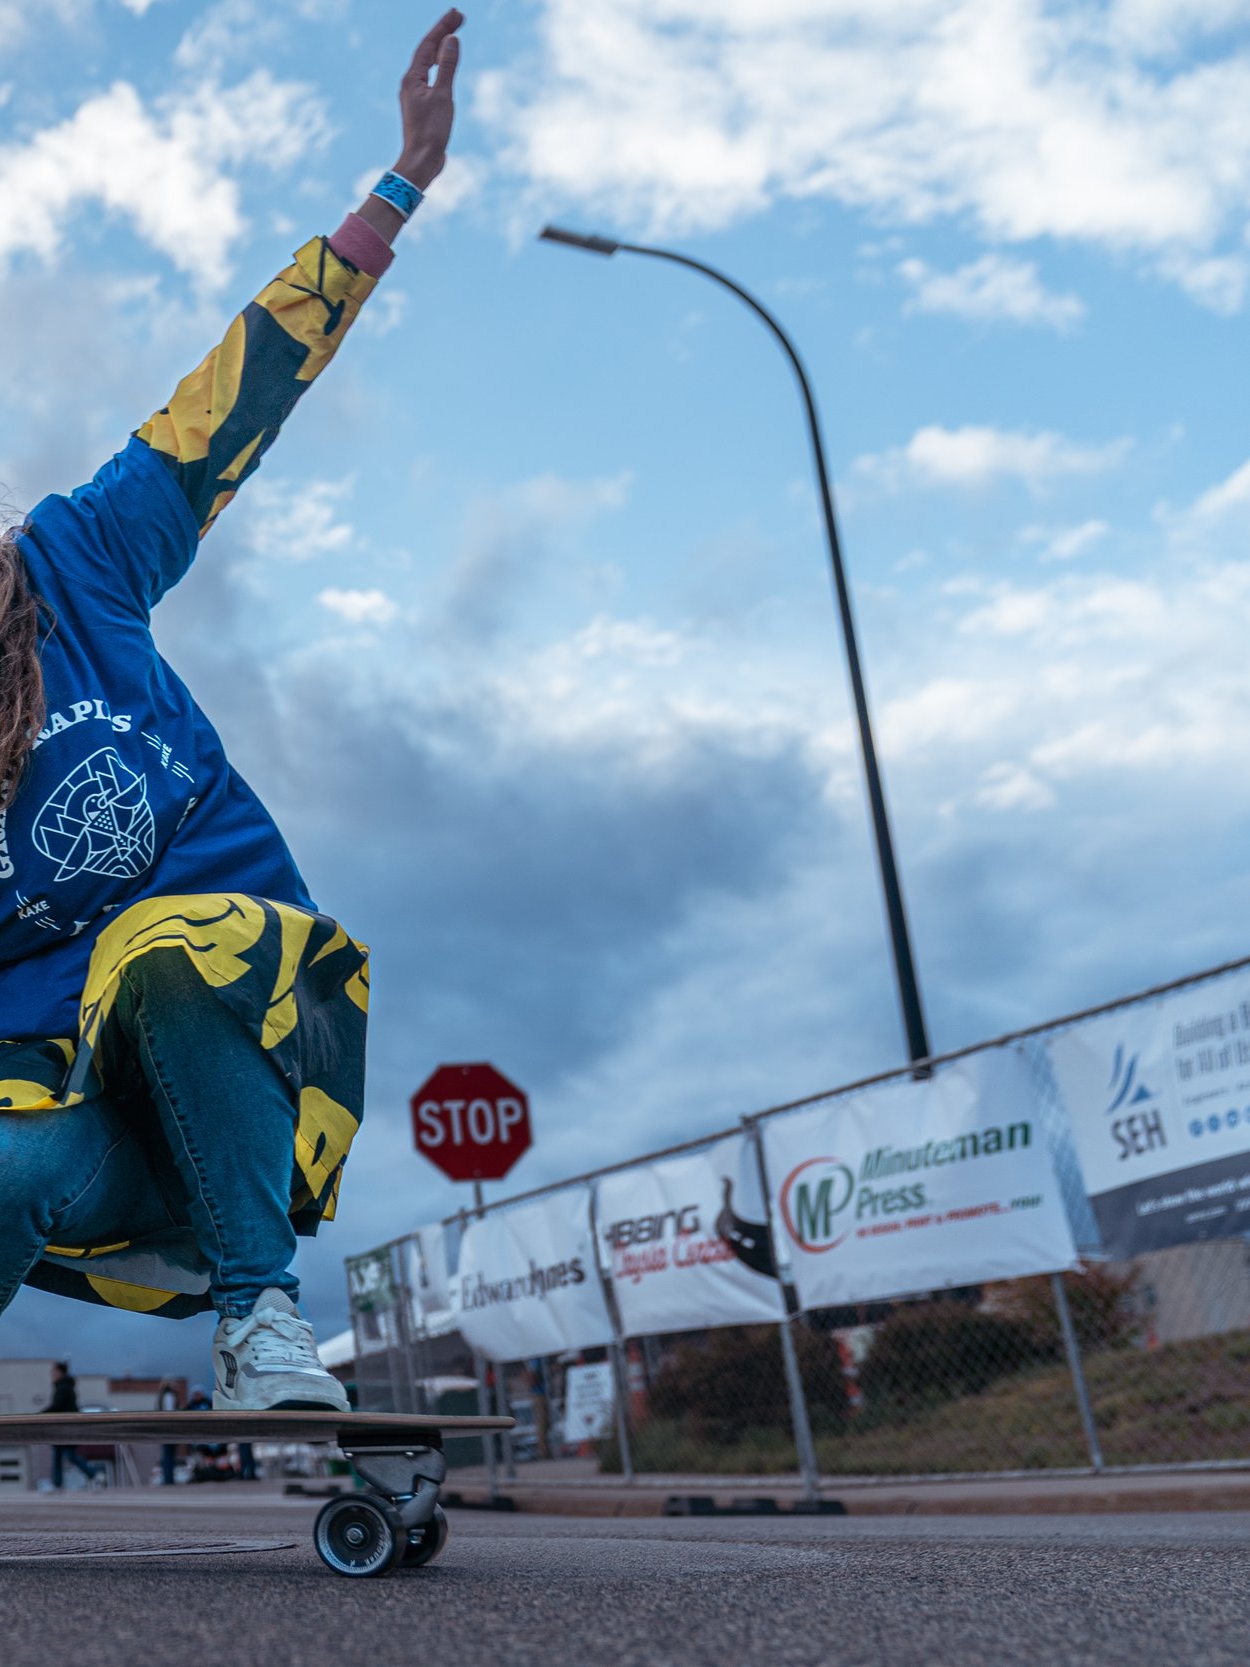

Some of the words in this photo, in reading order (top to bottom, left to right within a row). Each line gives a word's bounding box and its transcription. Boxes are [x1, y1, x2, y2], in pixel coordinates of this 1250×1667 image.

[31, 699, 132, 750] APIS
[17, 900, 50, 920] KAXE
[418, 1097, 523, 1148] STOP
[1111, 1107, 1168, 1161] SEH
[860, 1120, 1032, 1179] Minuteman
[855, 1181, 926, 1220] Press
